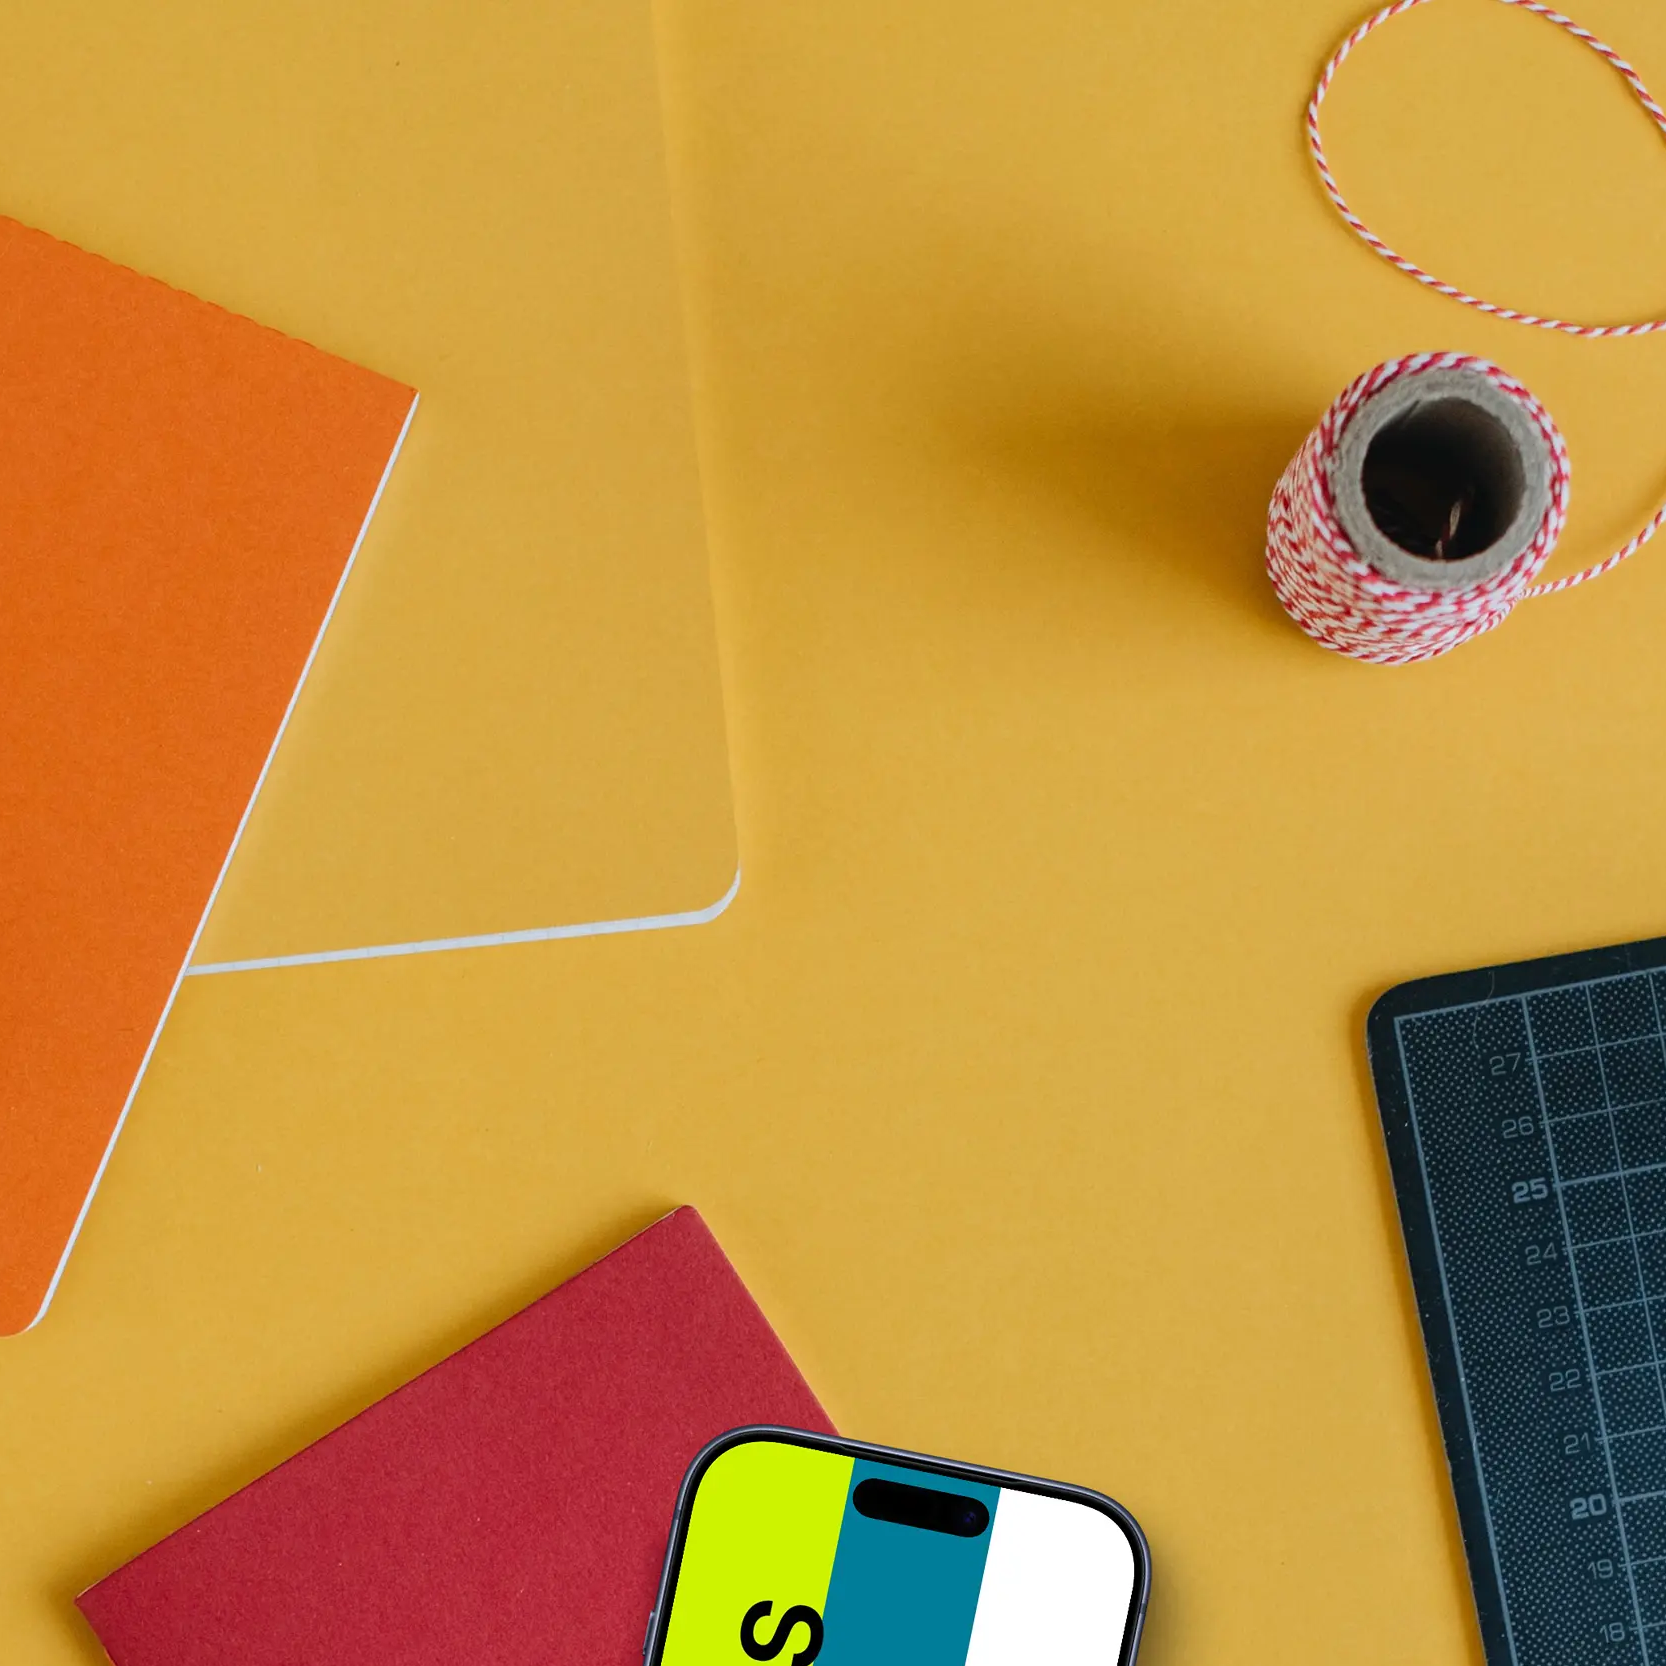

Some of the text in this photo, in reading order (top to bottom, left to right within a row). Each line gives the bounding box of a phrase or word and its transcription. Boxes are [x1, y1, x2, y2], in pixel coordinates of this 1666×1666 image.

[1489, 1052, 1522, 1076] 27
[1501, 1115, 1535, 1139] 26
[1511, 1177, 1549, 1203] 25
[1525, 1242, 1558, 1266] 24
[1536, 1305, 1571, 1329] 23
[1548, 1368, 1582, 1392] 22
[1563, 1433, 1591, 1455] 21
[1570, 1494, 1608, 1520] 20
[1588, 1559, 1614, 1579] 19
[1599, 1623, 1626, 1644] 18
